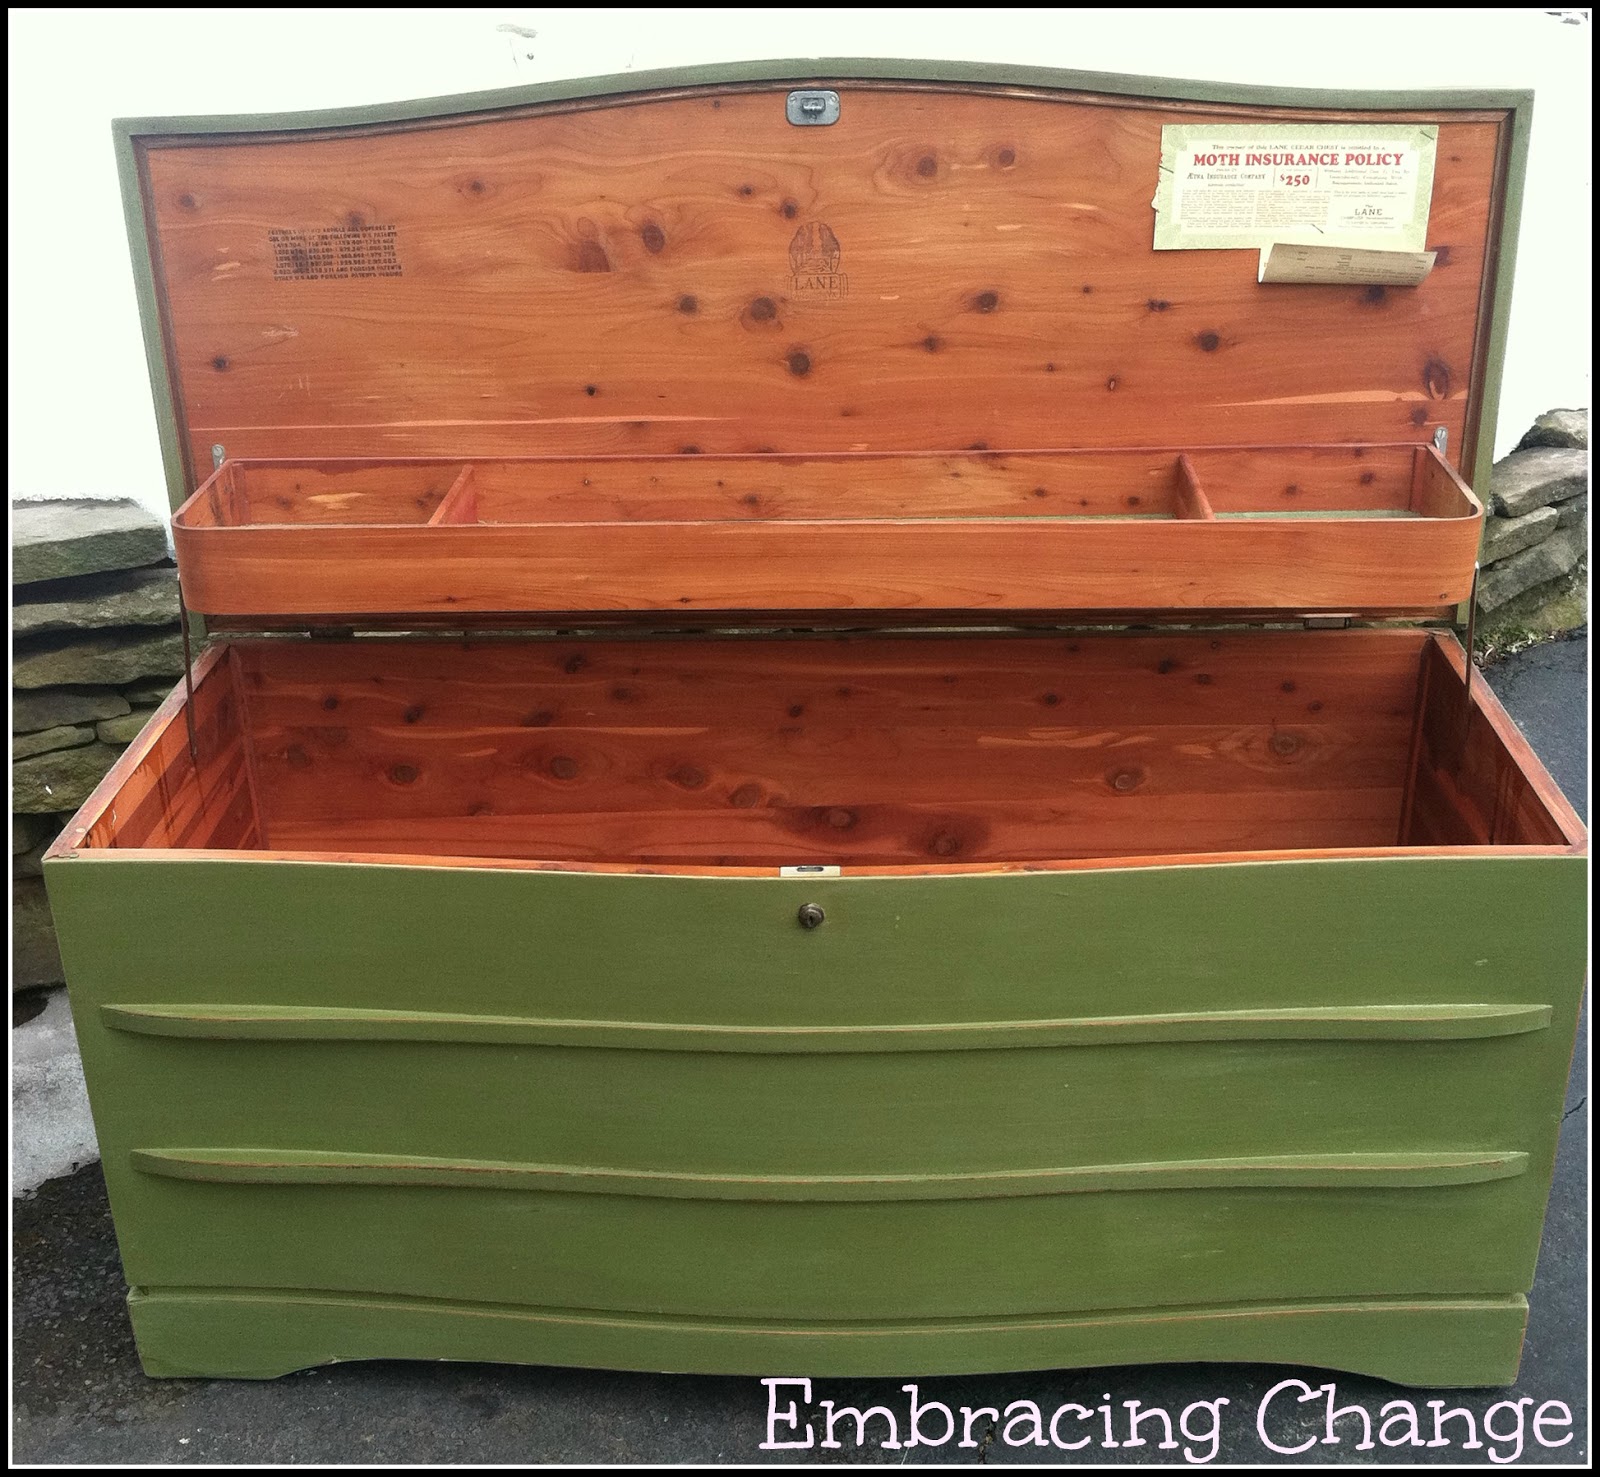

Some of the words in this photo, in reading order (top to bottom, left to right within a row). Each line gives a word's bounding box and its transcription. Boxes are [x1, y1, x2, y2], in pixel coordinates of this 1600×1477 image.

[1193, 153, 1240, 166] MOTH
[1245, 153, 1340, 166] INSURANCE
[1344, 153, 1404, 166] POLICY
[1279, 173, 1310, 187] $250
[1354, 208, 1383, 216] LANE
[795, 276, 838, 291] LANE
